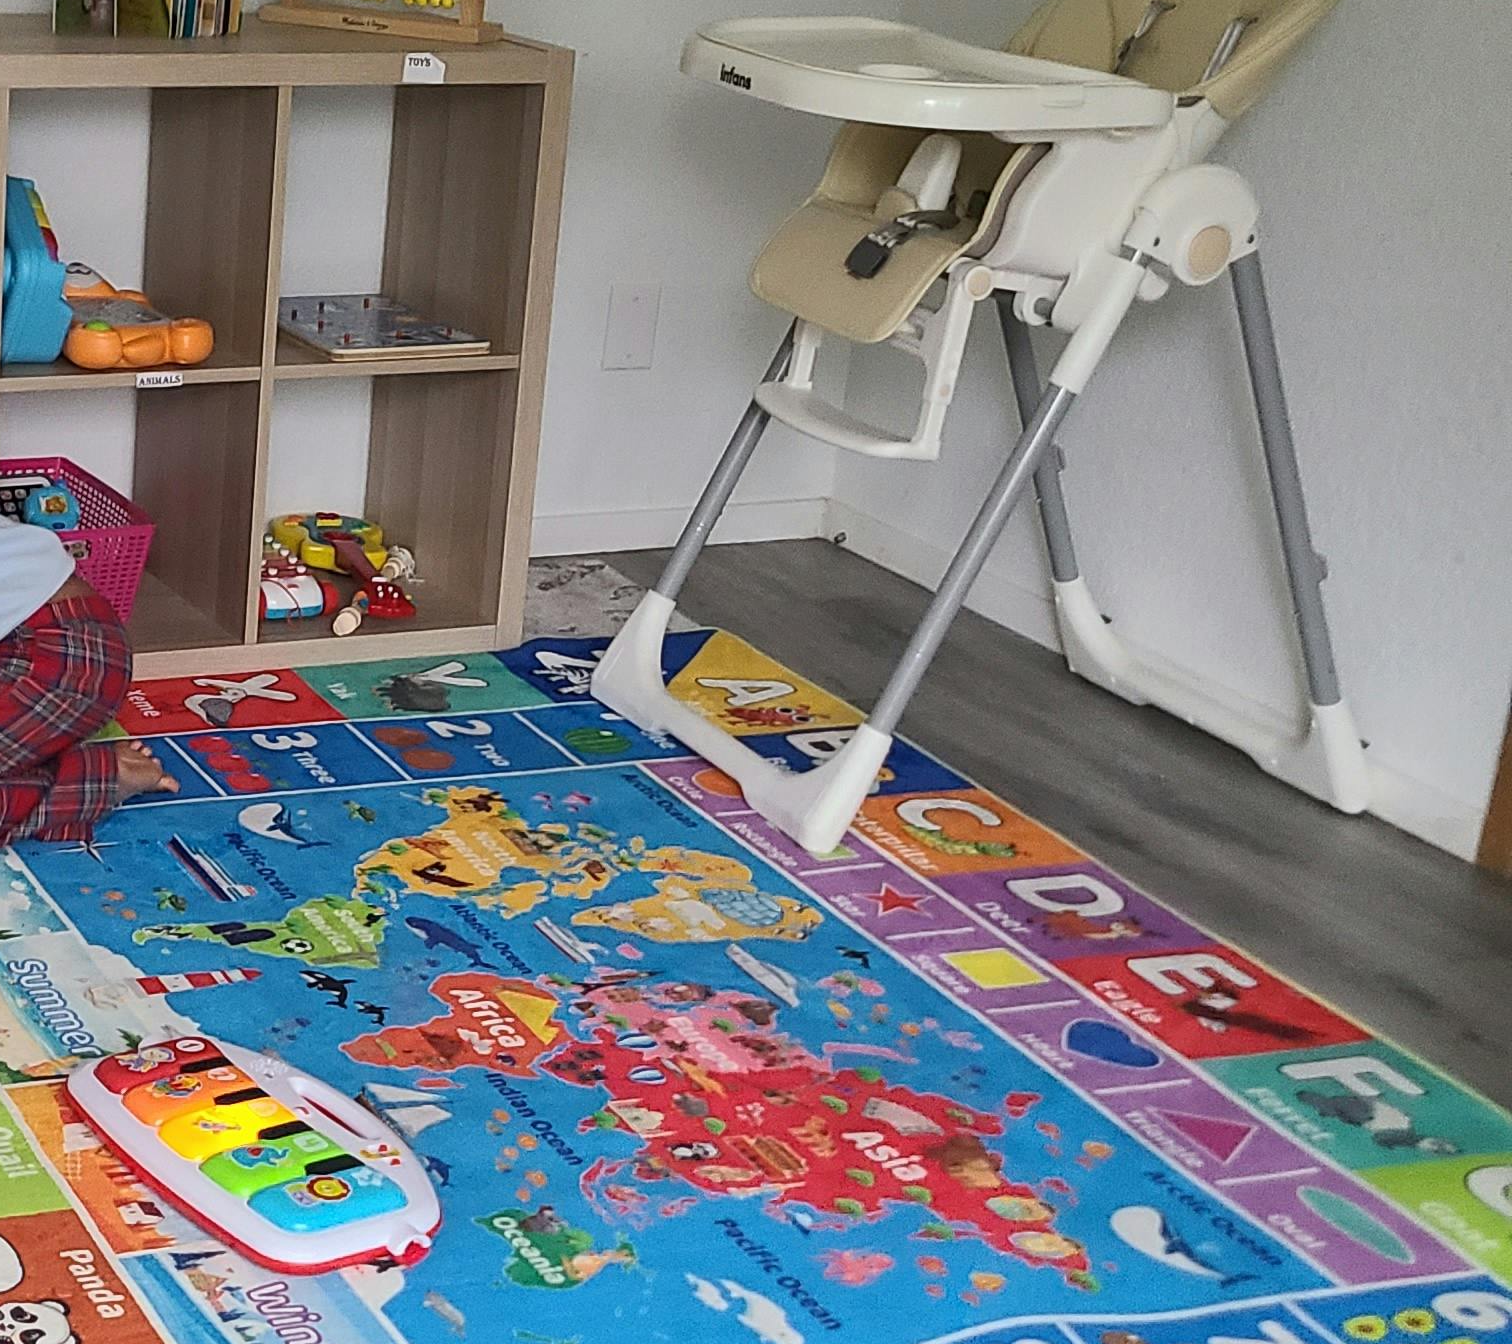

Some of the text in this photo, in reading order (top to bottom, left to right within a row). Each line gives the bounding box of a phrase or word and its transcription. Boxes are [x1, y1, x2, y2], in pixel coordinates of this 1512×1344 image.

[407, 57, 431, 68] TOYS
[720, 64, 752, 90] Infans
[139, 374, 181, 387] ANIMALS
[127, 689, 161, 719] Xeme
[325, 682, 356, 702] Yak
[695, 677, 797, 707] A
[251, 731, 319, 751] 3
[425, 719, 494, 739] 2
[292, 751, 336, 785] Three
[473, 744, 511, 768] Two
[620, 773, 699, 829] Arctic Ocean
[668, 776, 705, 801] Circle
[896, 797, 1004, 831] C
[440, 827, 497, 878] America
[473, 829, 517, 870] North
[729, 821, 799, 868] Rectangle
[223, 832, 298, 902] Pacific Ocean
[829, 895, 868, 917] Star
[1005, 872, 1126, 916] D
[302, 908, 354, 956] America
[333, 908, 376, 946] South
[975, 900, 1032, 933] Deer
[449, 903, 531, 976] Atlantic Ocean
[912, 953, 972, 996] Square
[1126, 953, 1258, 996] E
[6, 956, 104, 1059] Summer
[448, 987, 527, 1049] Africa
[1092, 979, 1163, 1027] Eagle
[664, 1014, 740, 1071] Europe
[1019, 1032, 1076, 1070] Heart
[1279, 1056, 1429, 1099] F
[485, 1071, 584, 1168] Indian Ocean
[1246, 1085, 1336, 1144] Ferret
[840, 1130, 928, 1182] Asia
[1124, 1109, 1206, 1170] Triangle
[1144, 1168, 1284, 1268] Arctic Ocean
[1267, 1212, 1328, 1253] Oval
[491, 1214, 567, 1286] Oceania
[59, 1245, 127, 1323] Panda
[714, 1217, 842, 1332] Pacific Ocean
